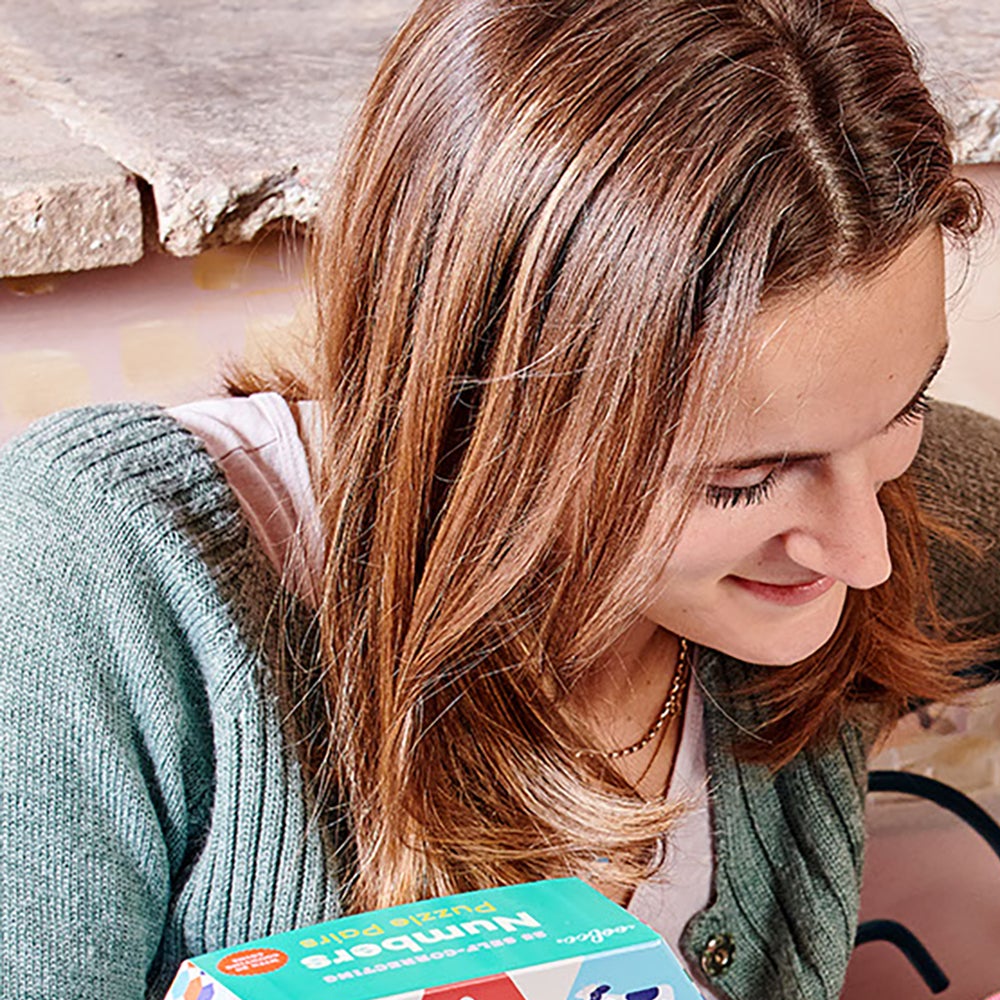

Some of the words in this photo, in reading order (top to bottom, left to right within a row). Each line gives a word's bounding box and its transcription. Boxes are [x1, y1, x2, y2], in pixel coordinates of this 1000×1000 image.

[390, 900, 497, 927] Puzzle
[299, 923, 384, 949] Pairs
[300, 911, 541, 969] Numbers
